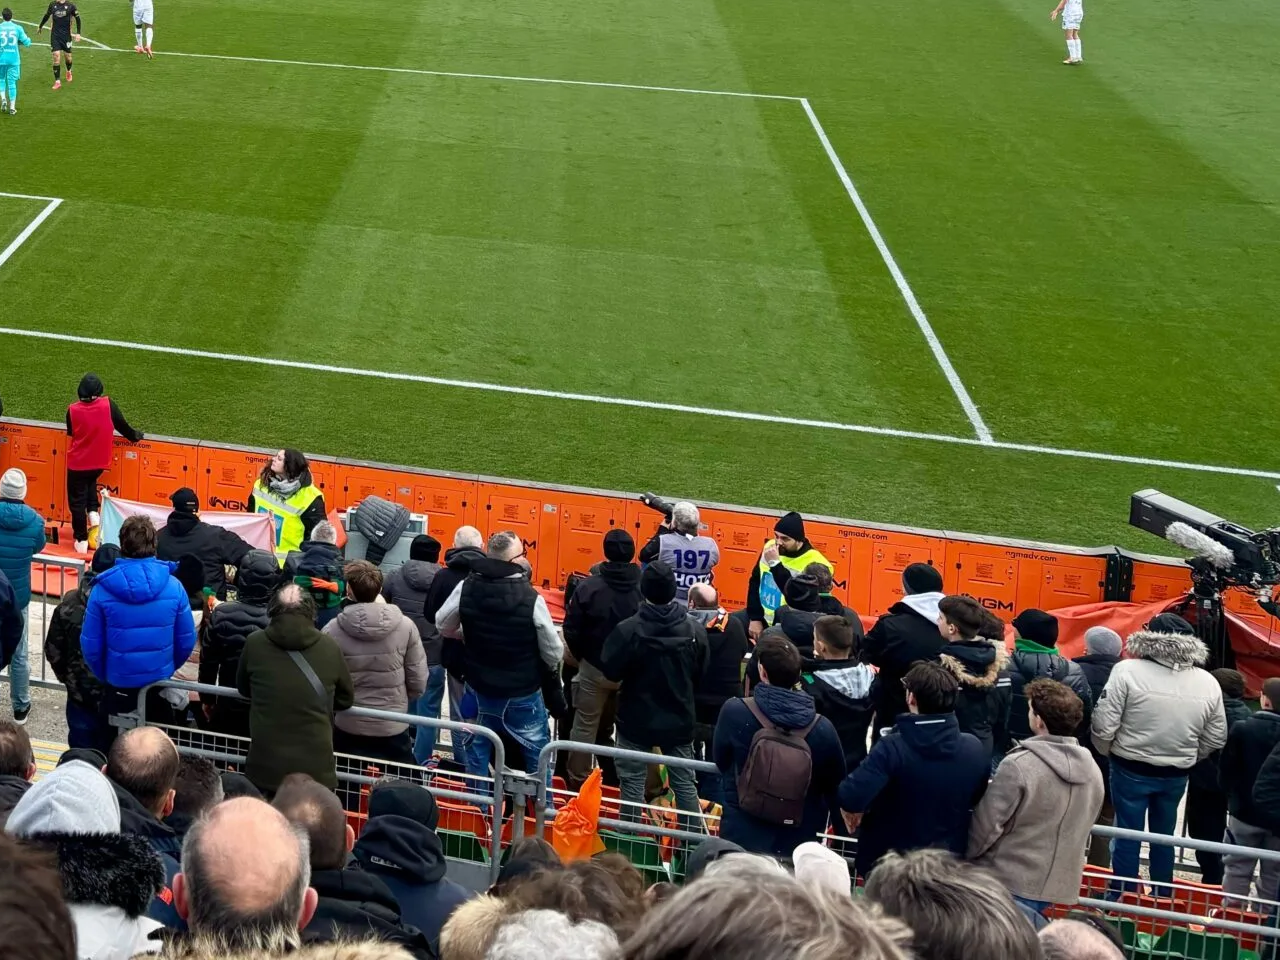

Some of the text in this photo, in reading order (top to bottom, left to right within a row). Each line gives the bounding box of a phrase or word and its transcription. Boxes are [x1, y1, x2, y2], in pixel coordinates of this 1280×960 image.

[838, 528, 888, 541] ngmadv.com
[673, 549, 710, 570] 197
[1005, 551, 1057, 563] ngmadv.com
